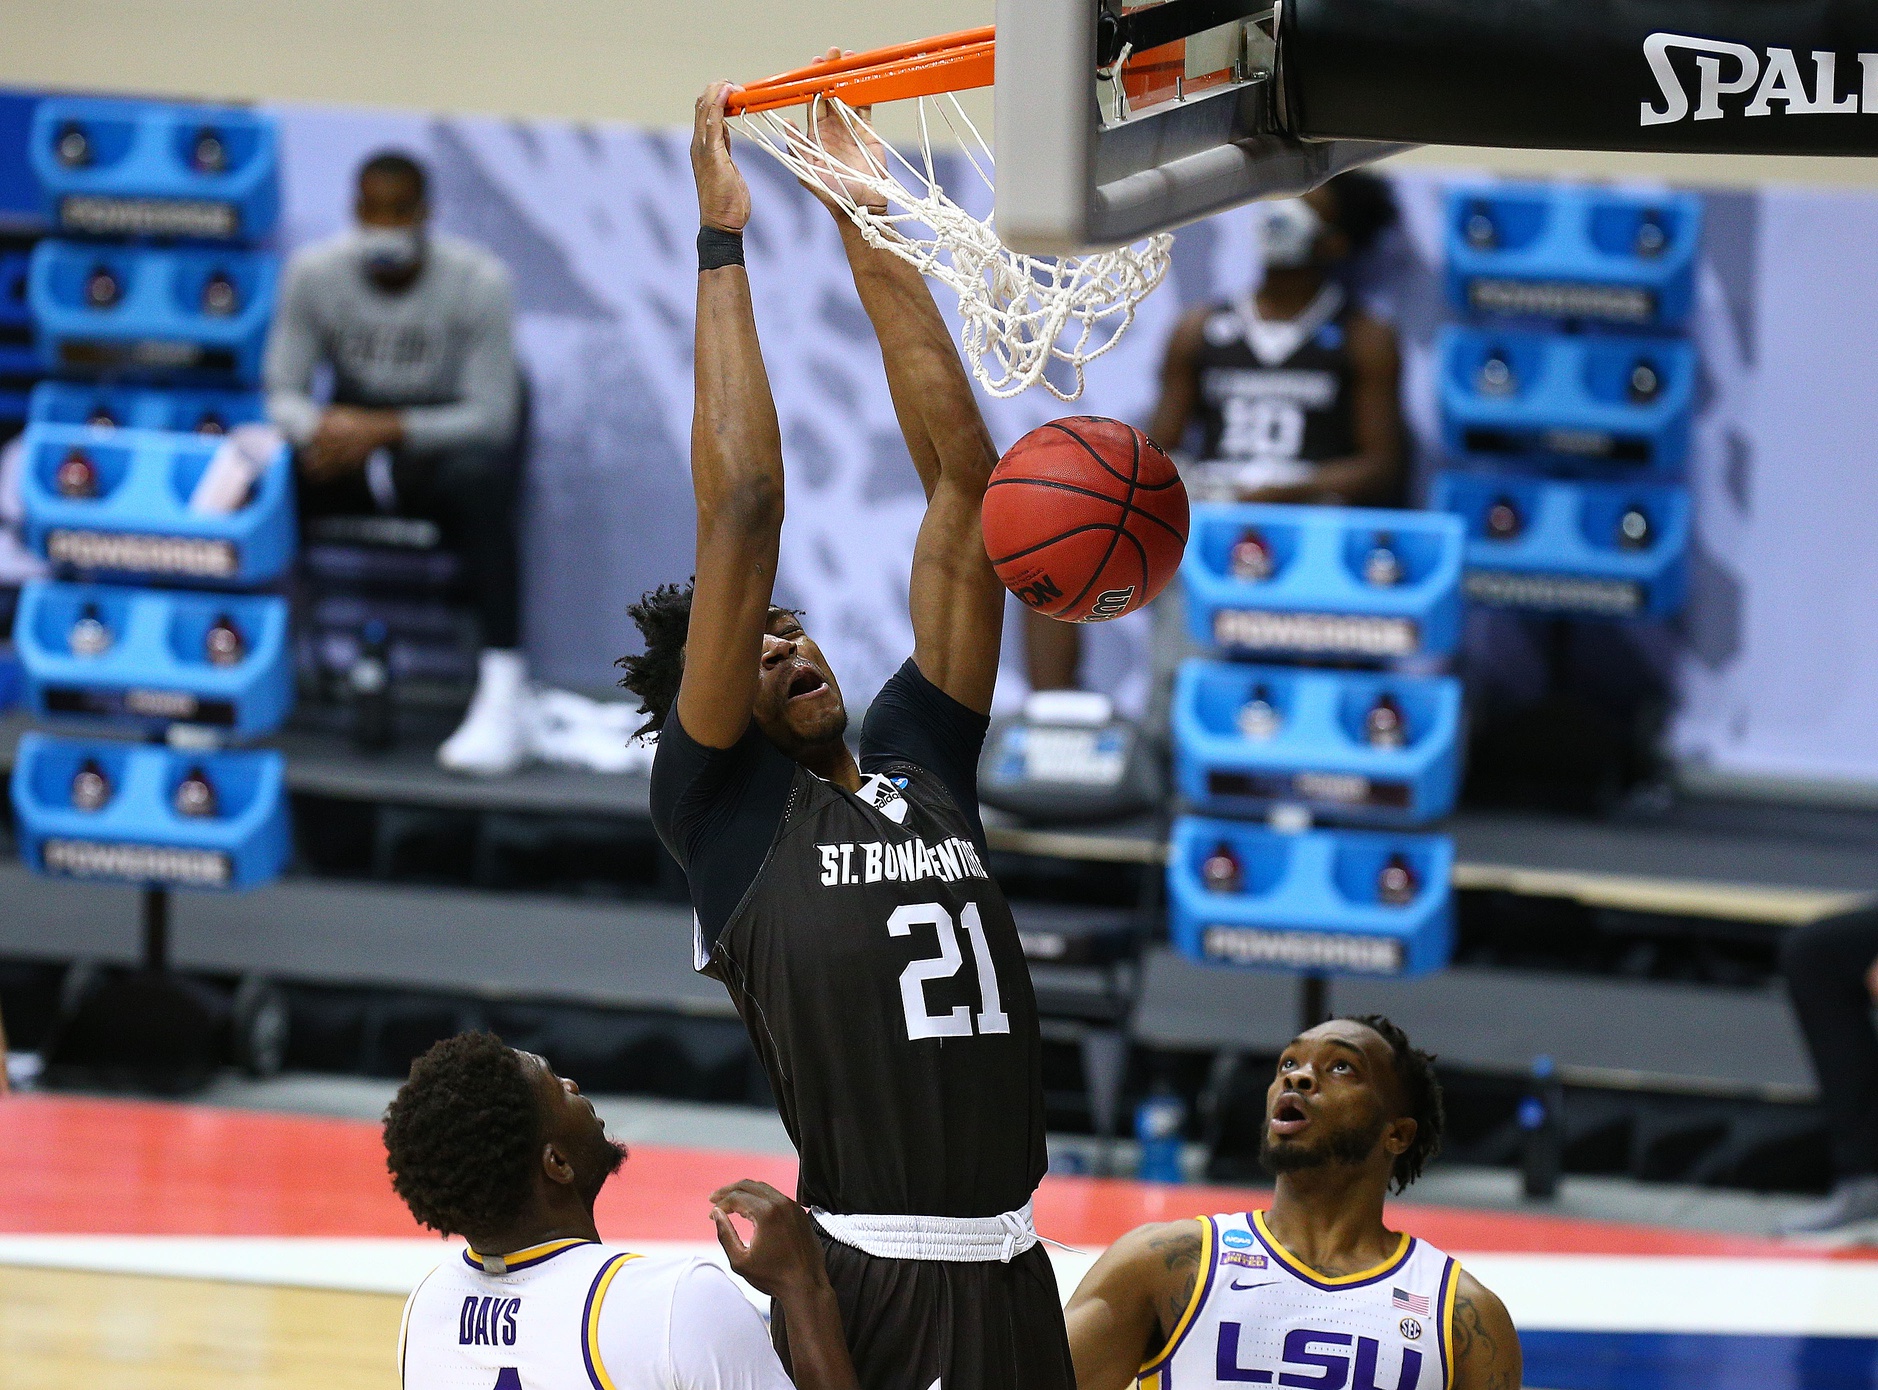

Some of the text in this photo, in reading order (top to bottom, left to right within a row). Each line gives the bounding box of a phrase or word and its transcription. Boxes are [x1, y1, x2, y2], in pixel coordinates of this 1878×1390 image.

[816, 843, 859, 887] ST.
[886, 901, 1011, 1041] 21
[1223, 1255, 1265, 1267] UNITED
[1224, 1235, 1252, 1245] NCAA
[458, 1296, 522, 1346] DAYS
[1400, 1318, 1421, 1339] SEC
[1216, 1320, 1423, 1390] LSU
